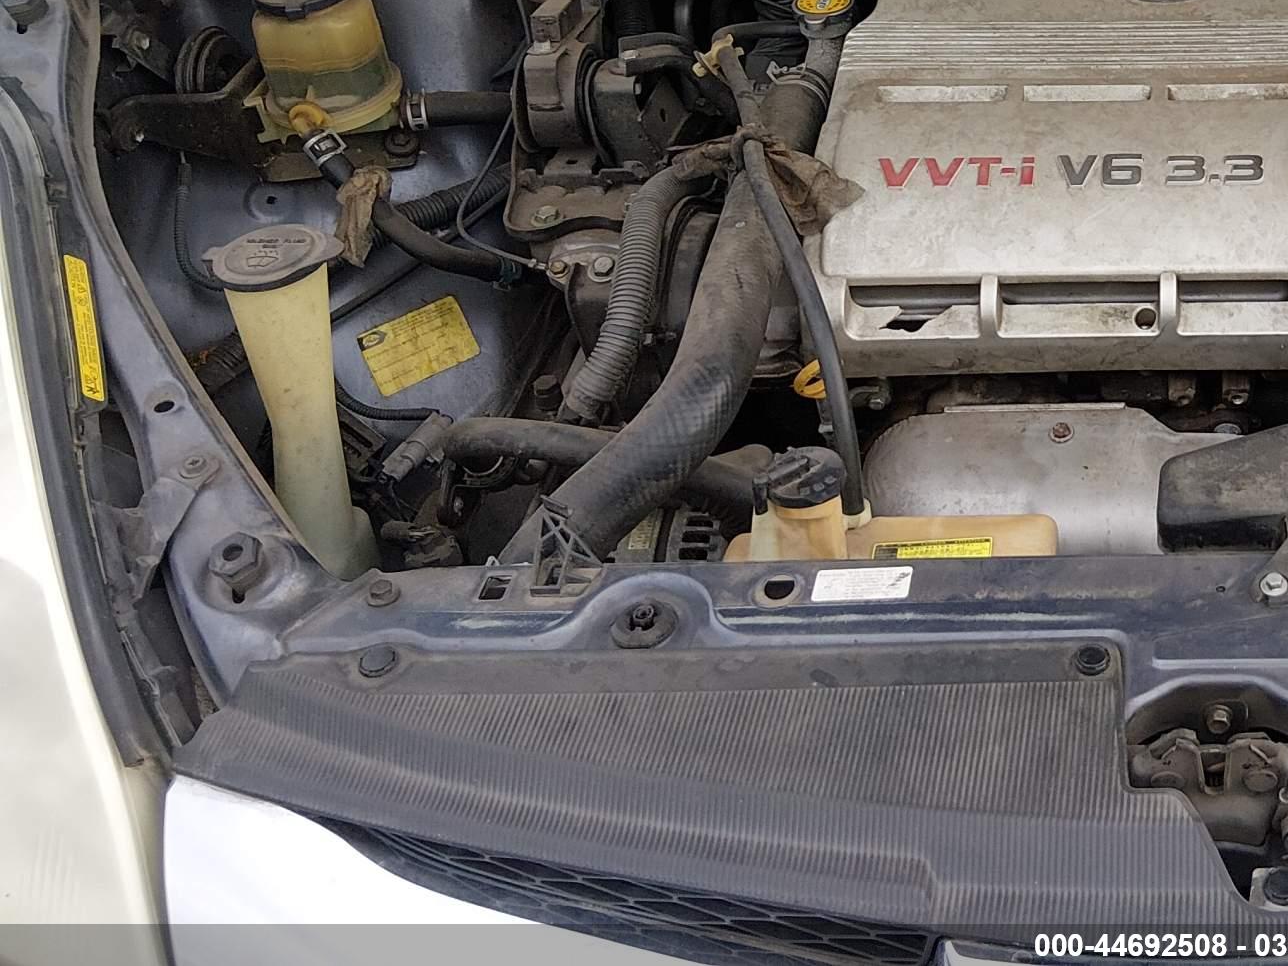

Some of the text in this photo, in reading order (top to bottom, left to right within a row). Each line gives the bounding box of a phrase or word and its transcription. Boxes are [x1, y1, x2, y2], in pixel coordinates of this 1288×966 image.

[878, 153, 1265, 188] VVT-i V6 3.3
